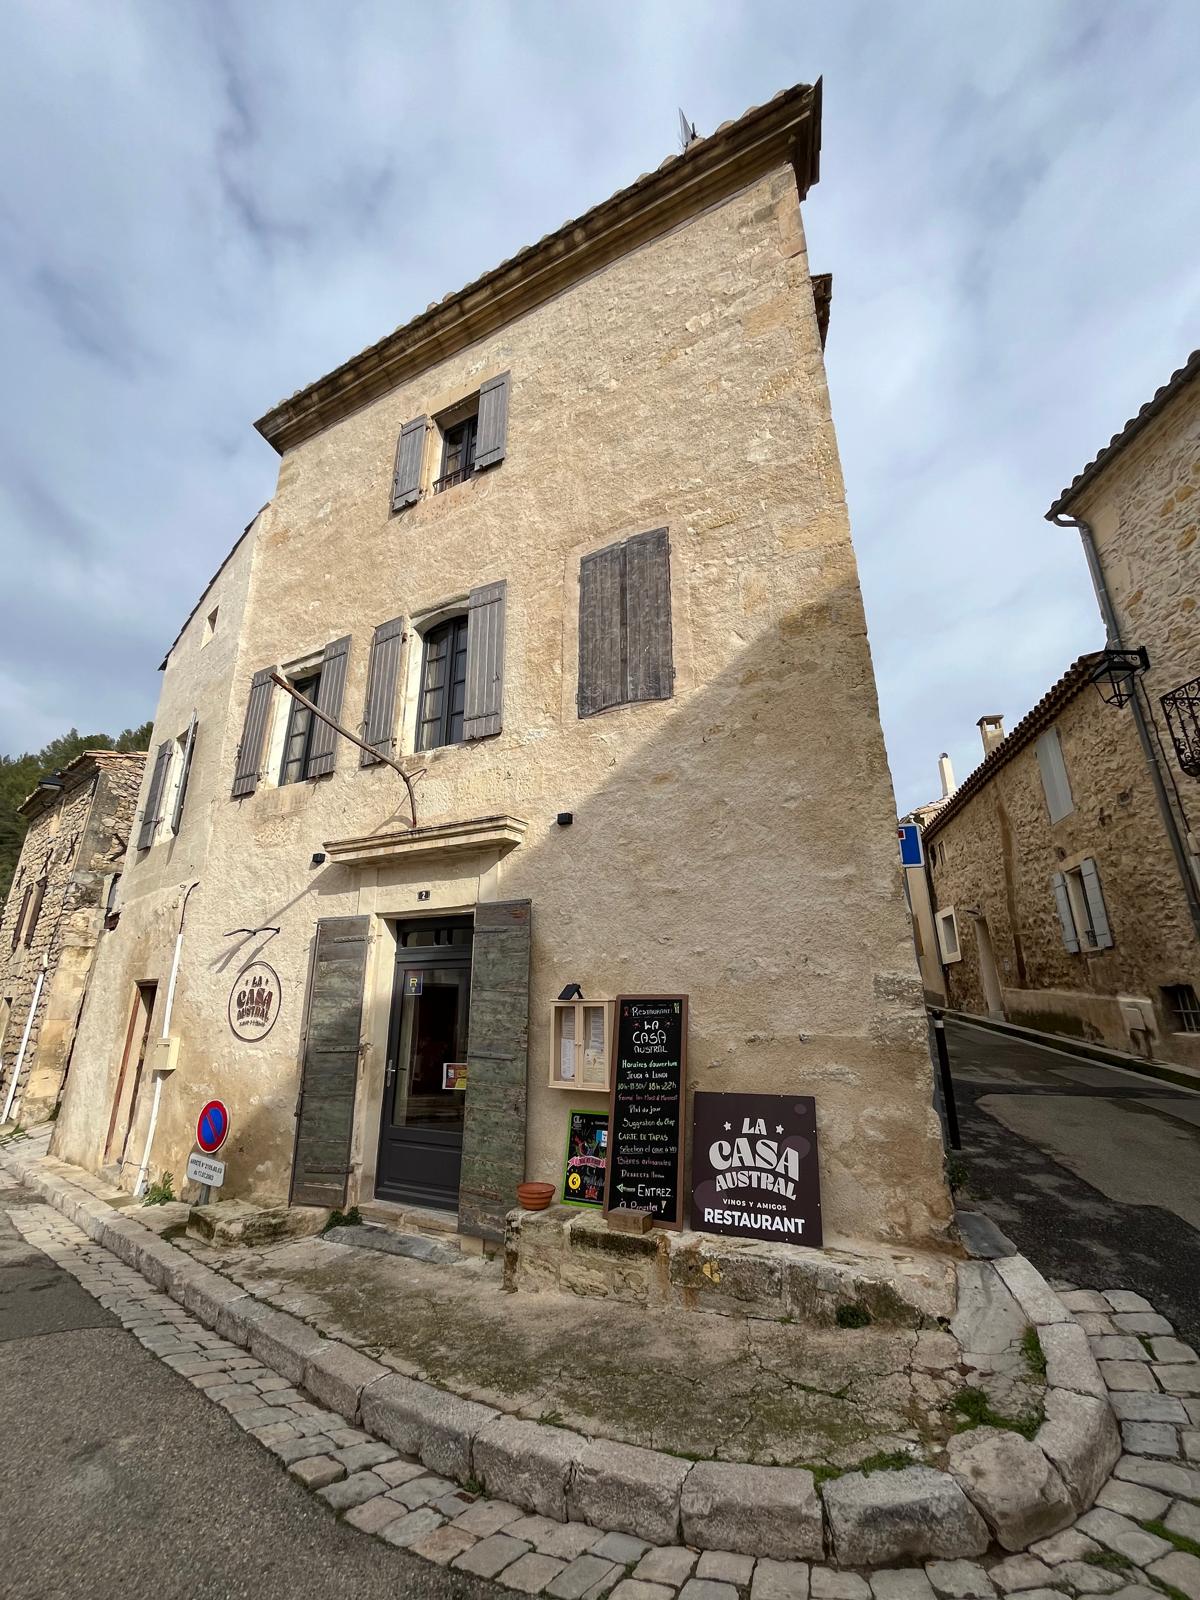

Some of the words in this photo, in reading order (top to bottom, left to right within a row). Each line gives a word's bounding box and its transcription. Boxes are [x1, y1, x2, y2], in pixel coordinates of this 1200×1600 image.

[644, 1020, 659, 1030] LA
[632, 1030, 667, 1044] CASA
[633, 1045, 668, 1054] AUSTRAL
[622, 1059, 648, 1069] Horaires
[742, 1117, 767, 1135] LA
[709, 1137, 799, 1181] CASA
[716, 1170, 797, 1201] AUSTRAL
[722, 1198, 746, 1207] VINOS
[757, 1202, 787, 1211] AMIGOS
[704, 1207, 805, 1235] RESTAURANT
